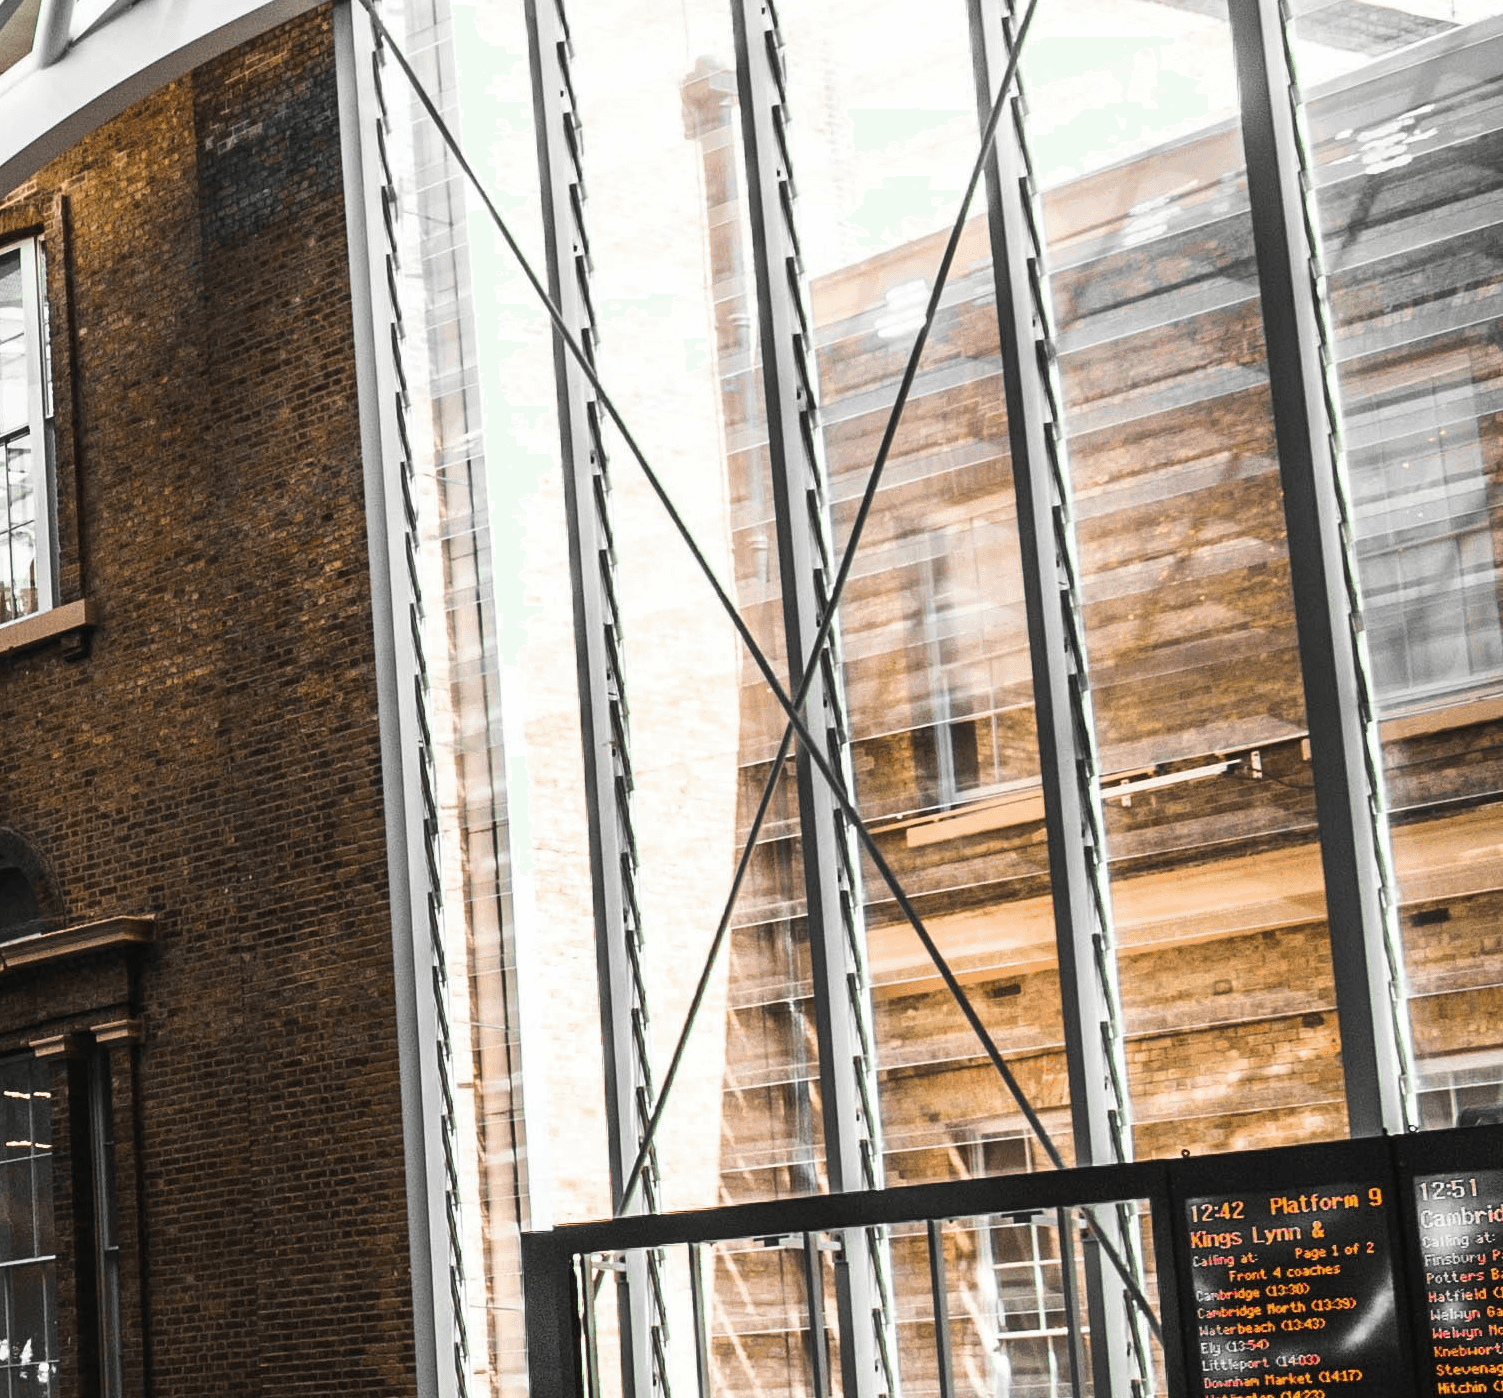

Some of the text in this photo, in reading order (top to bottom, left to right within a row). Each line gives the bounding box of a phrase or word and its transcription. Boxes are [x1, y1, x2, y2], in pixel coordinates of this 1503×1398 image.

[1420, 1178, 1478, 1201] 12:51
[1191, 1187, 1382, 1222] 12:42 Platform 9
[1191, 1221, 1325, 1248] Kings Lynn &
[1422, 1232, 1495, 1249] Calling at:
[1193, 1254, 1234, 1267] Calling
[1295, 1247, 1326, 1261] Page
[1332, 1245, 1338, 1256] 1
[1345, 1243, 1359, 1255] of
[1366, 1242, 1374, 1253] 2
[1424, 1249, 1503, 1267] Finsbury P
[1229, 1263, 1341, 1282] Front 4 coaches
[1426, 1270, 1484, 1285] Potters
[1196, 1283, 1310, 1302] Cambridge (13:30)
[1428, 1288, 1487, 1302] Hatfield
[1198, 1305, 1261, 1319] Cambridge
[1267, 1302, 1306, 1315] North
[1430, 1307, 1480, 1323] Welwyn
[1199, 1317, 1326, 1337] Waterbeach (13:43)
[1432, 1326, 1482, 1340] Welwyn
[1200, 1339, 1270, 1356] Ely (13:54)
[1434, 1343, 1503, 1358] Knebwort
[1202, 1354, 1321, 1372] Littleport (14:03)
[1204, 1375, 1259, 1389] Downham
[1265, 1372, 1313, 1386] Market
[1438, 1380, 1487, 1394] Hitchin
